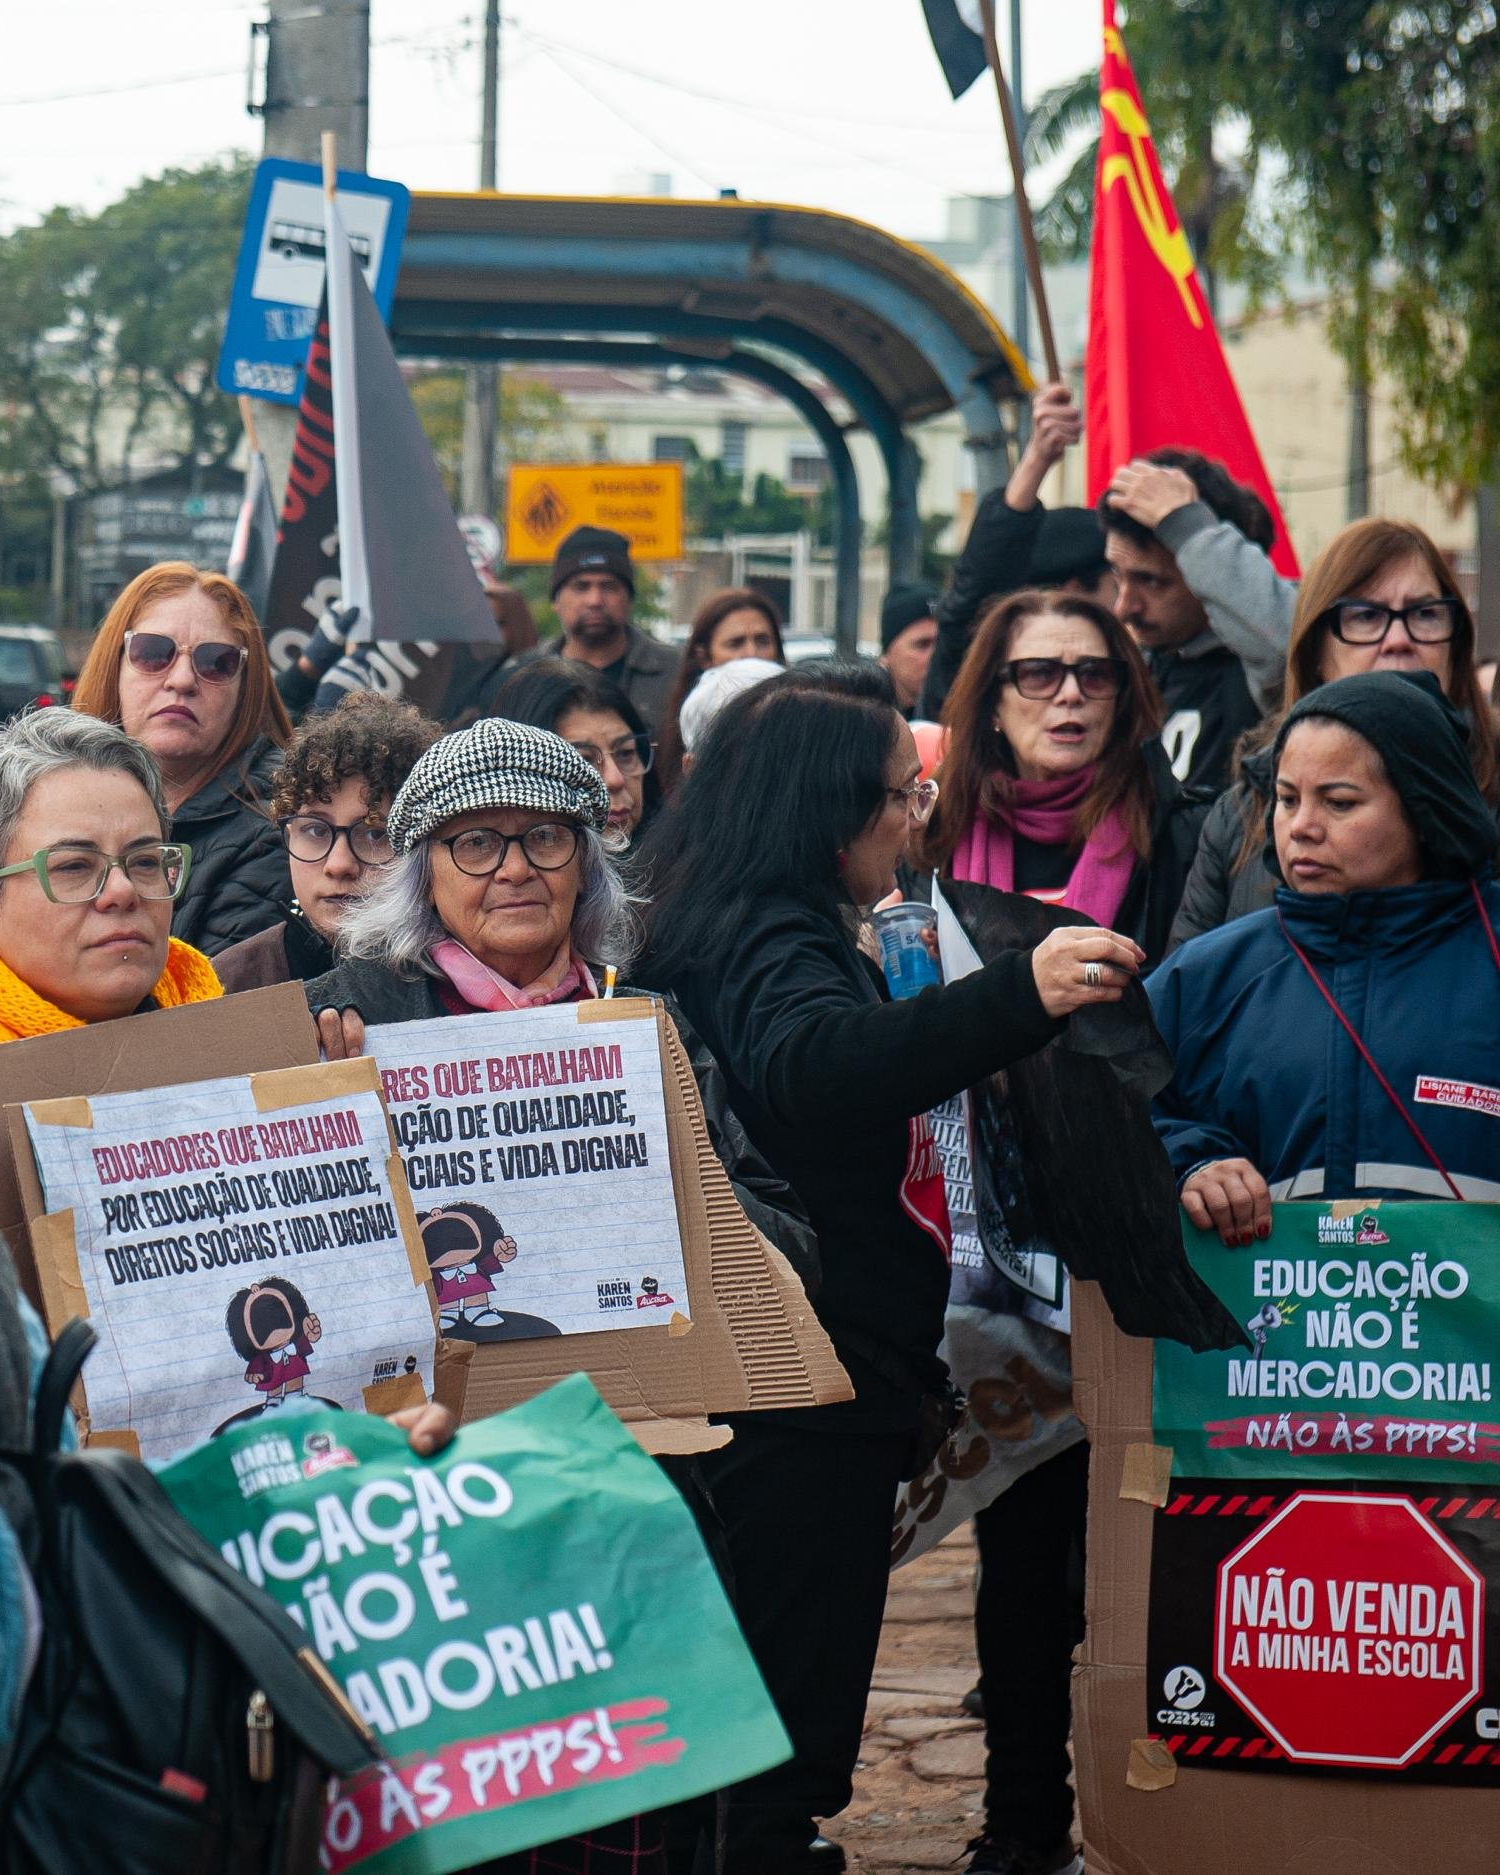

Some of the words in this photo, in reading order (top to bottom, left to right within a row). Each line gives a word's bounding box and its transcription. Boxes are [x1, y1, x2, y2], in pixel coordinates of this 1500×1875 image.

[433, 1060, 483, 1098] QUE
[486, 1045, 623, 1092] BATALHAM
[457, 1104, 489, 1141] DE
[493, 1090, 636, 1137] QUALIDADE,
[92, 1131, 220, 1185] EDUCADORES
[217, 1125, 261, 1167] QUE
[257, 1110, 364, 1160] BATALHAM
[402, 1150, 476, 1190] CIAIS
[479, 1148, 495, 1183] E
[497, 1142, 560, 1181] VIDA
[562, 1132, 649, 1175] DIGNA!
[101, 1193, 147, 1236] POR
[141, 1171, 250, 1228] EDUCAÇÃO
[245, 1173, 277, 1211] DE
[271, 1156, 382, 1208] QUALIDADE,
[104, 1235, 198, 1286] DIREITOS
[195, 1221, 277, 1270] SOCIAIS
[273, 1219, 291, 1257] E
[285, 1213, 335, 1255] VIDA
[328, 1201, 398, 1248] DIGNA!
[1318, 1230, 1354, 1243] SANTOS
[597, 1281, 631, 1297] KAREN
[598, 1295, 633, 1309] SANTOS
[1253, 1252, 1469, 1312] EDUCAÇÃO
[1306, 1302, 1392, 1350] NÃO
[1401, 1301, 1419, 1350] É
[373, 1360, 399, 1377] KAREN
[1227, 1359, 1492, 1402] MERCADORIA!
[1245, 1411, 1319, 1451] NÃO
[1330, 1412, 1375, 1453] ÀS
[1384, 1421, 1479, 1454] PPPS!
[286, 1571, 416, 1661] ÃO
[418, 1533, 469, 1623] É
[1231, 1567, 1314, 1631] NÃO
[1326, 1579, 1465, 1640] VENDA
[345, 1602, 614, 1735] ADORIA!
[1231, 1631, 1250, 1668] A
[1257, 1632, 1350, 1674] MINHA
[1357, 1638, 1465, 1681] ESCOLA
[460, 1707, 624, 1807] PPPS!
